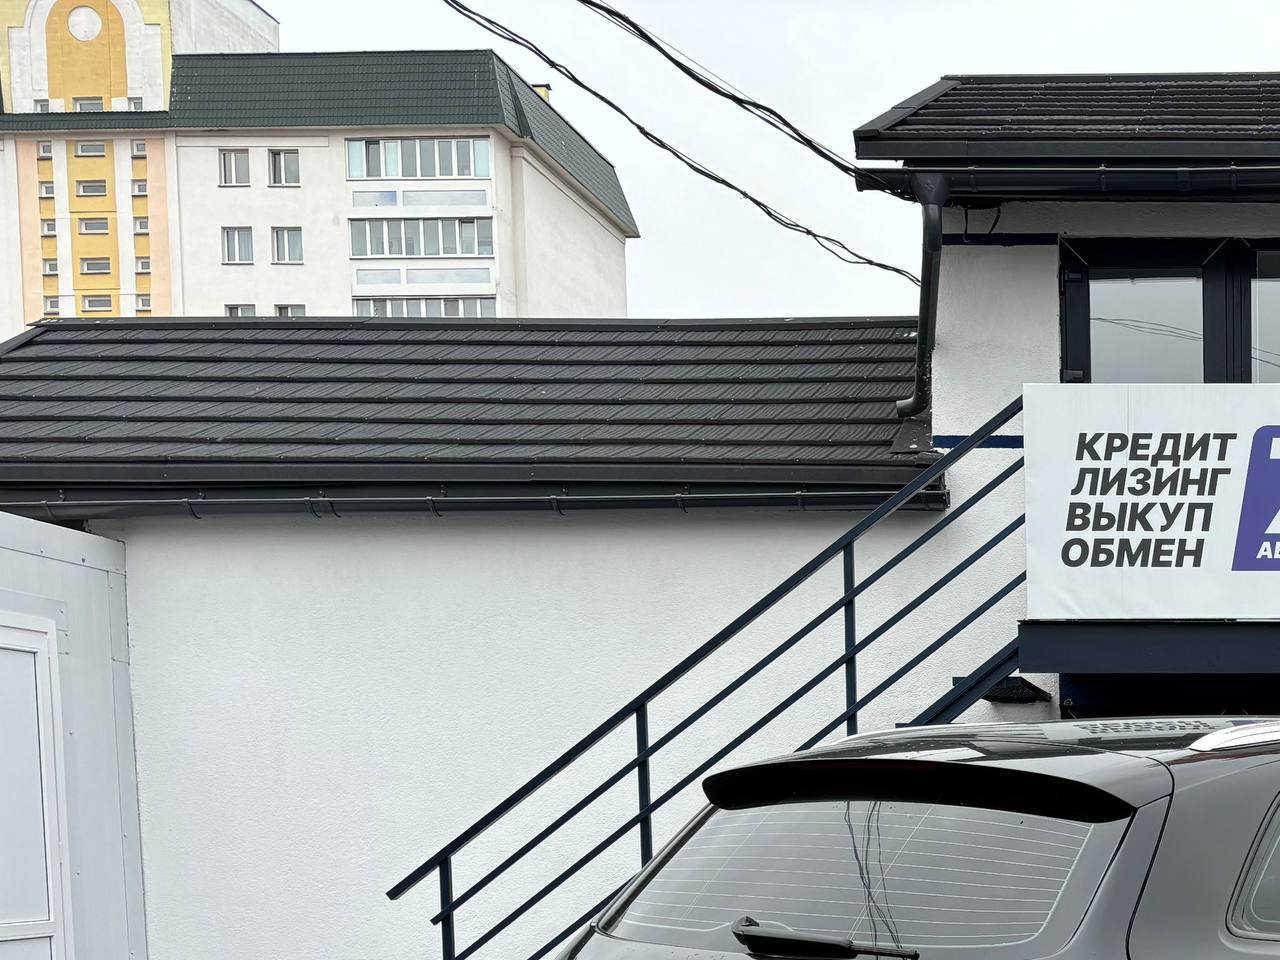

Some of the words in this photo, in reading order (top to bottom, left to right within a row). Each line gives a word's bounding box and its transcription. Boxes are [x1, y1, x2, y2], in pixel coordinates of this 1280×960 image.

[1075, 432, 1237, 467] КРЕДИТ
[1070, 467, 1231, 496] ЛИЗИНГ
[1065, 502, 1213, 532] ВЫКУП
[1061, 537, 1205, 568] ОБМЕН
